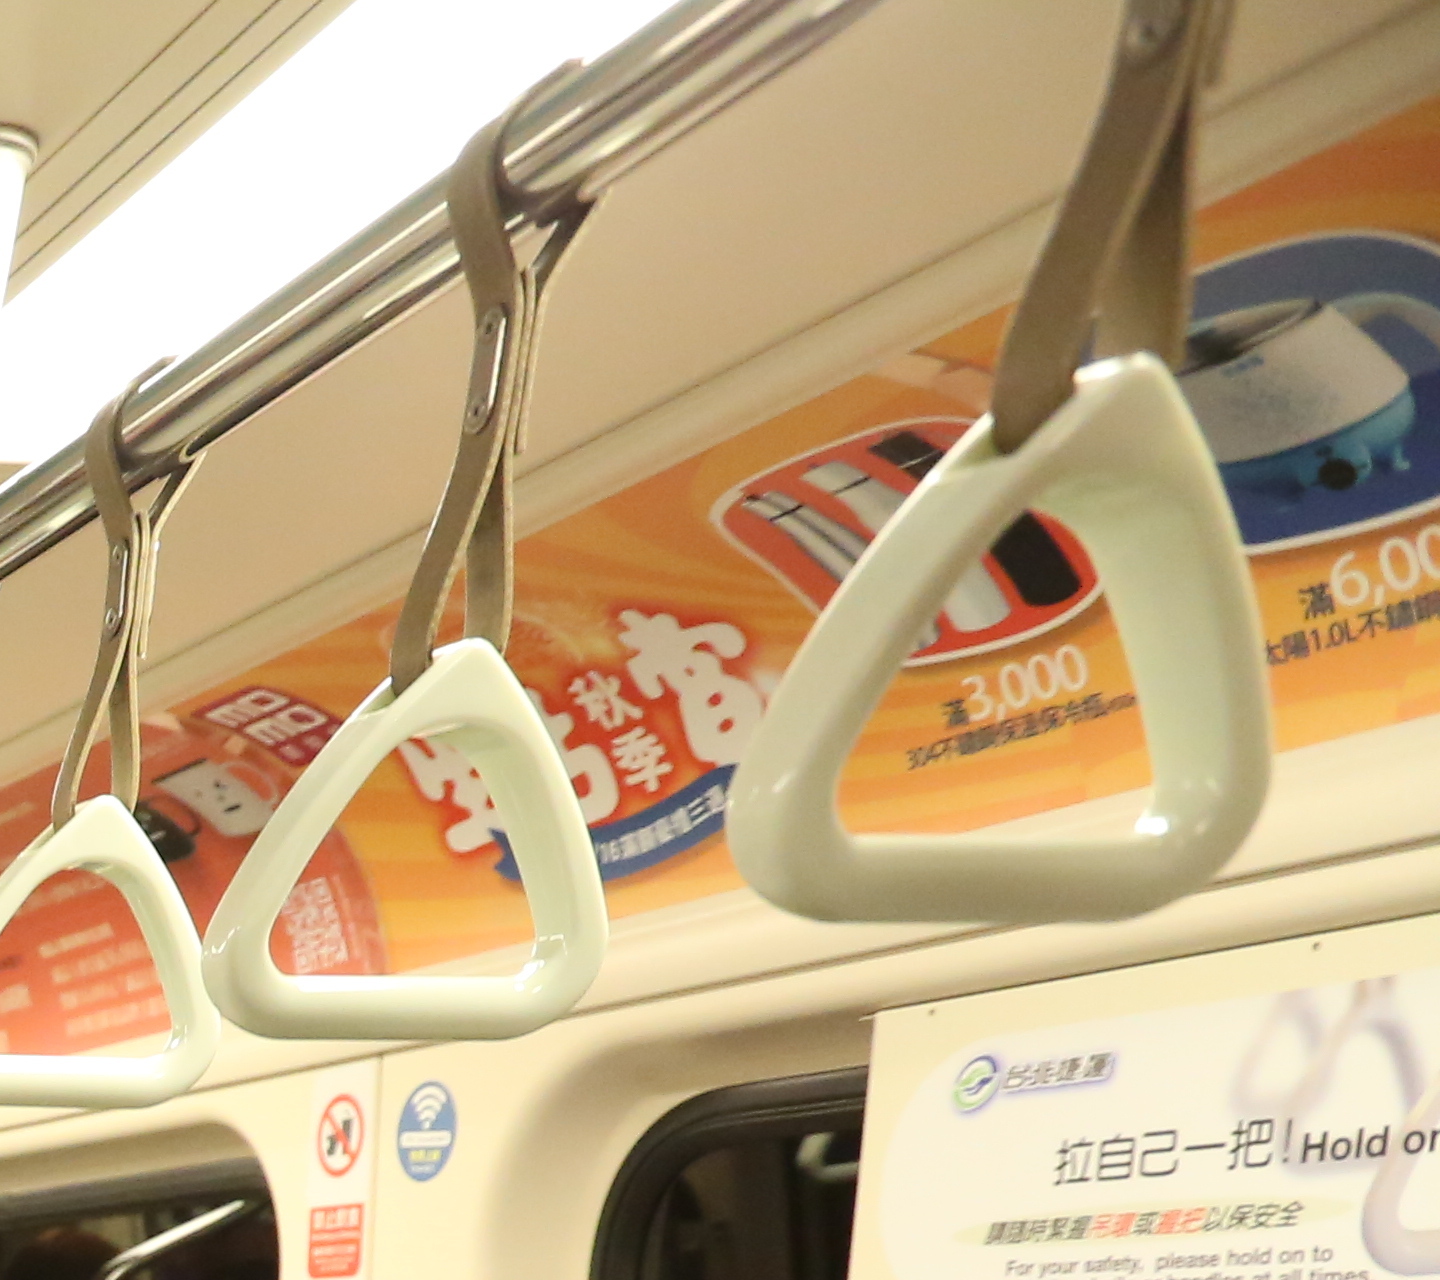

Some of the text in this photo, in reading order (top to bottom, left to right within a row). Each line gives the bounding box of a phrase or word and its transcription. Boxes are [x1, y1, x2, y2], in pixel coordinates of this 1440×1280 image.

[961, 643, 1089, 722] 3,000
[567, 671, 674, 795] 秋季
[1300, 1125, 1389, 1164] Hold
[1005, 1259, 1035, 1277] For
[1038, 1259, 1075, 1280] your
[1154, 1250, 1220, 1275] please
[1226, 1247, 1271, 1267] hold
[1278, 1249, 1305, 1265] on
[1311, 1246, 1334, 1263] to
